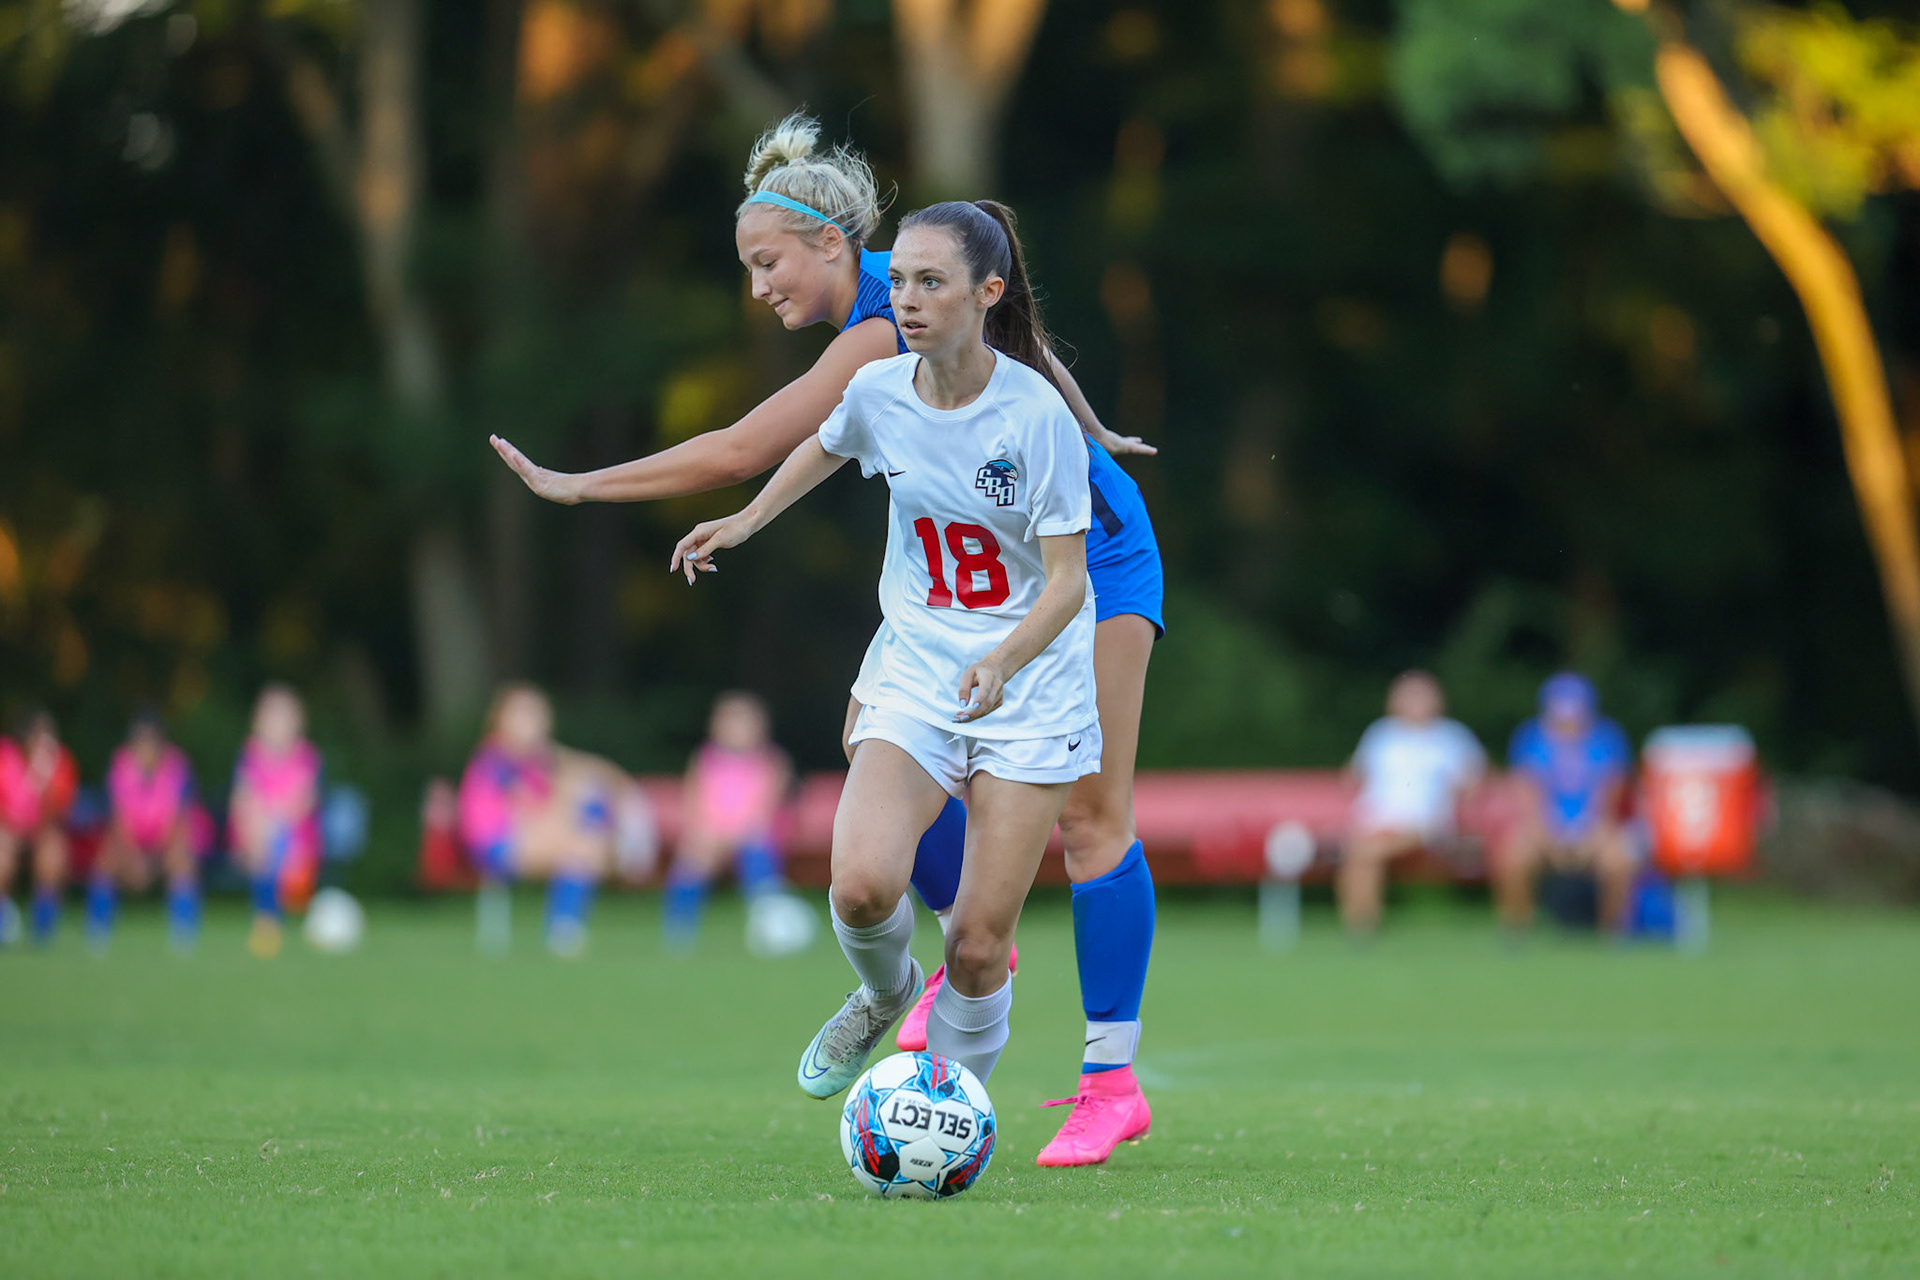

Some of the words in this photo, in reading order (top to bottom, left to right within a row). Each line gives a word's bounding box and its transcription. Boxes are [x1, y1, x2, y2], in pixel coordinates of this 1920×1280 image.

[977, 468, 1014, 506] SBA
[913, 517, 1010, 609] 18
[888, 1101, 972, 1140] SELECT
